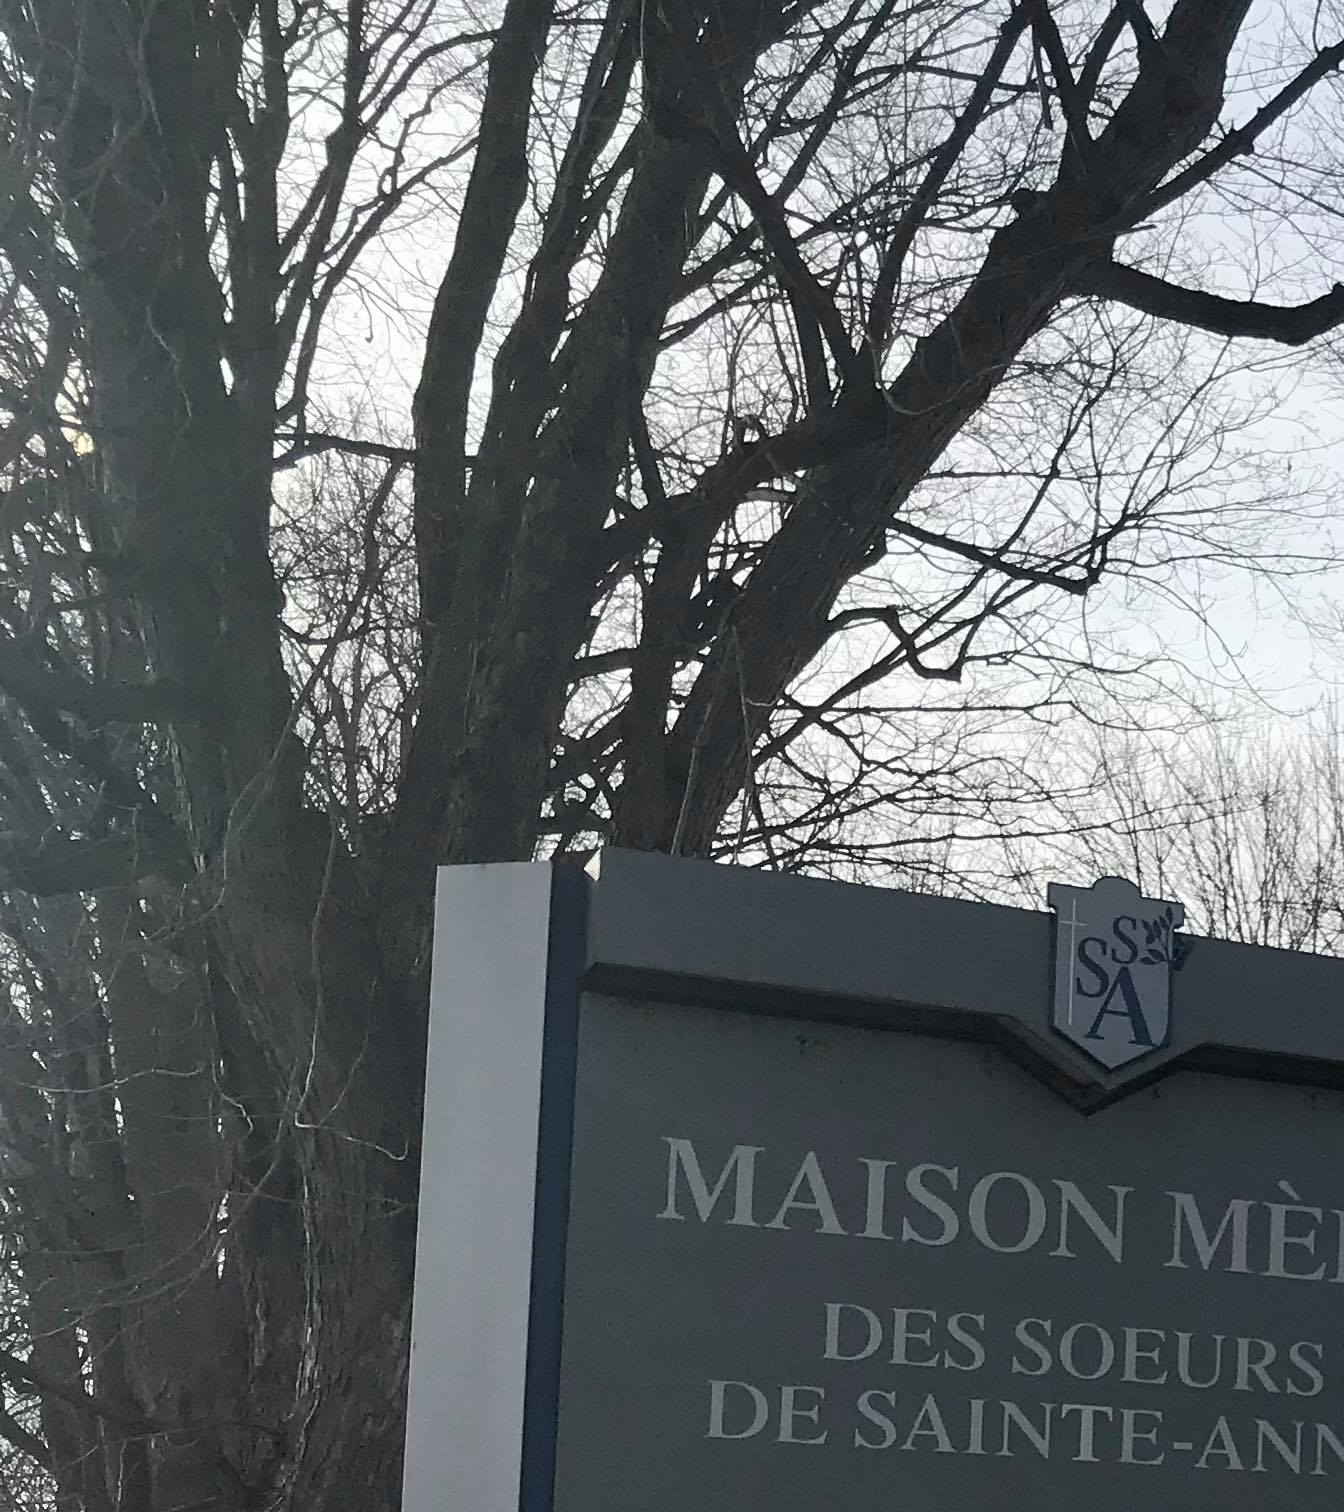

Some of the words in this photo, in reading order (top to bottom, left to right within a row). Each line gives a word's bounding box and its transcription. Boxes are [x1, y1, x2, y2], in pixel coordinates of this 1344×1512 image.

[656, 1136, 1134, 1263] MAISON
[823, 1301, 987, 1373] DES
[1012, 1316, 1324, 1396] SOEURS
[704, 1379, 829, 1446] DE
